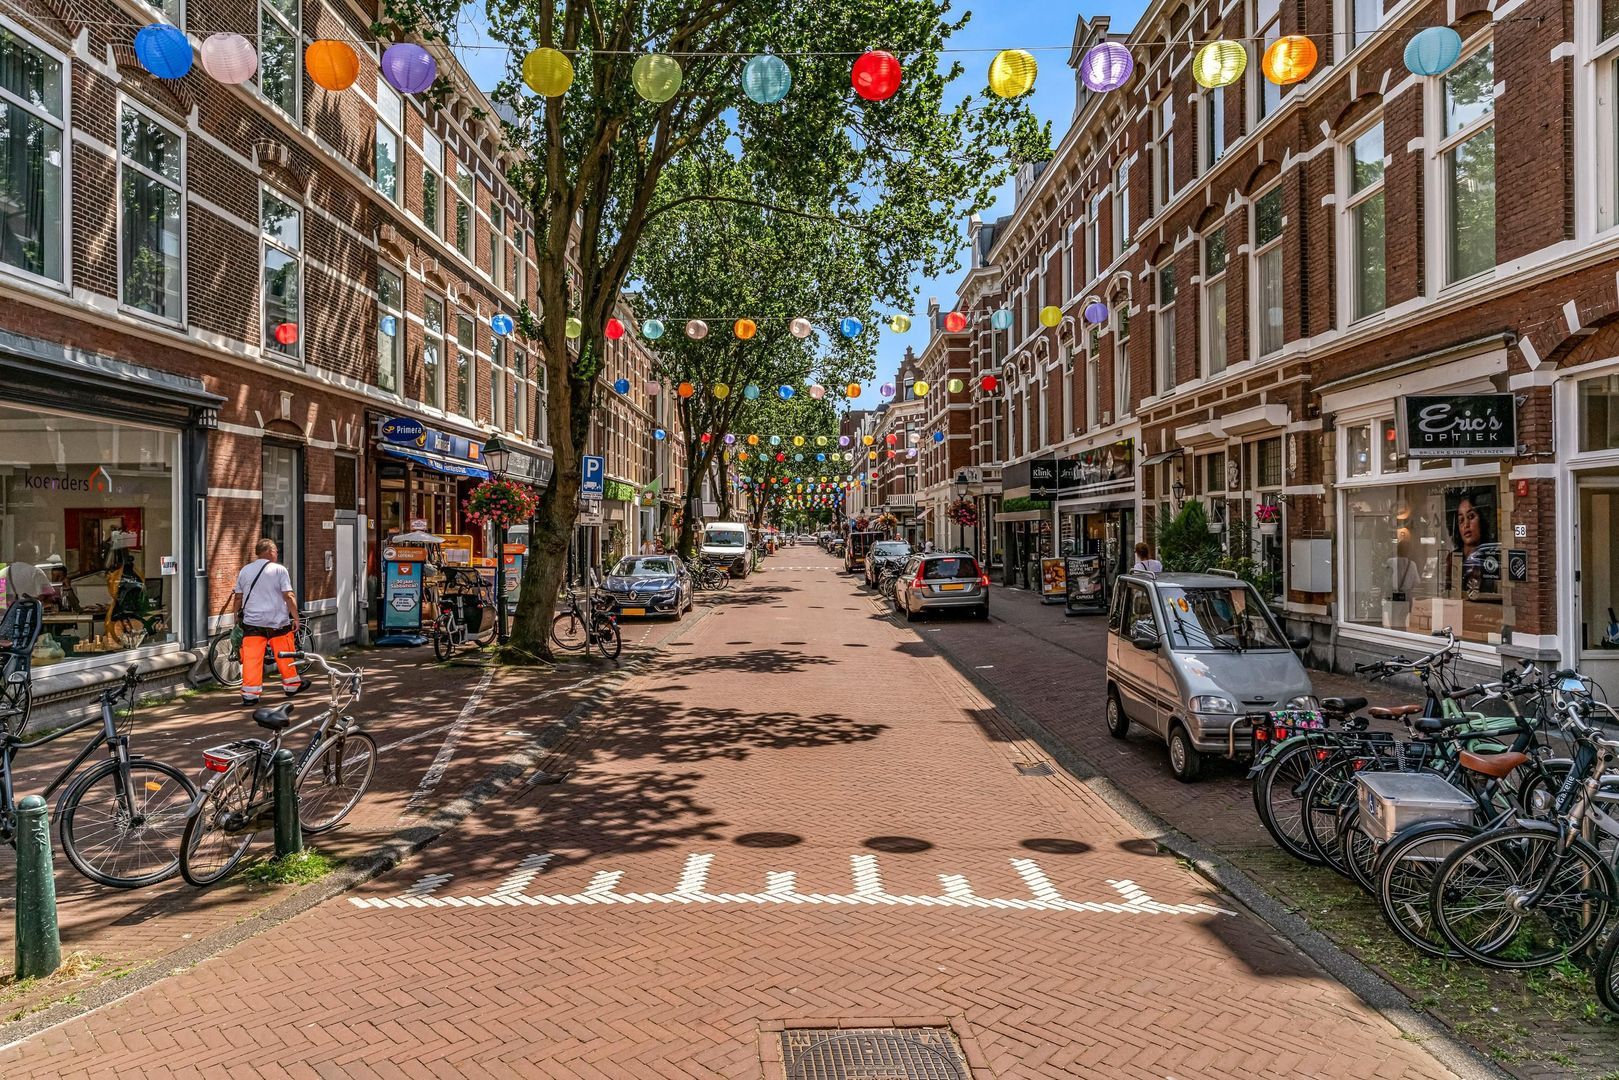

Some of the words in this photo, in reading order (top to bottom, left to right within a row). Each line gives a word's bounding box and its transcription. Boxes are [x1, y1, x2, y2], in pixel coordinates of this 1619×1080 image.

[1419, 404, 1502, 432] Eric's
[396, 425, 422, 434] Primera
[1425, 433, 1498, 441] OPTIEK
[587, 459, 600, 478] P
[1032, 466, 1053, 477] Klink
[24, 471, 90, 492] koenders
[1515, 526, 1526, 536] 58
